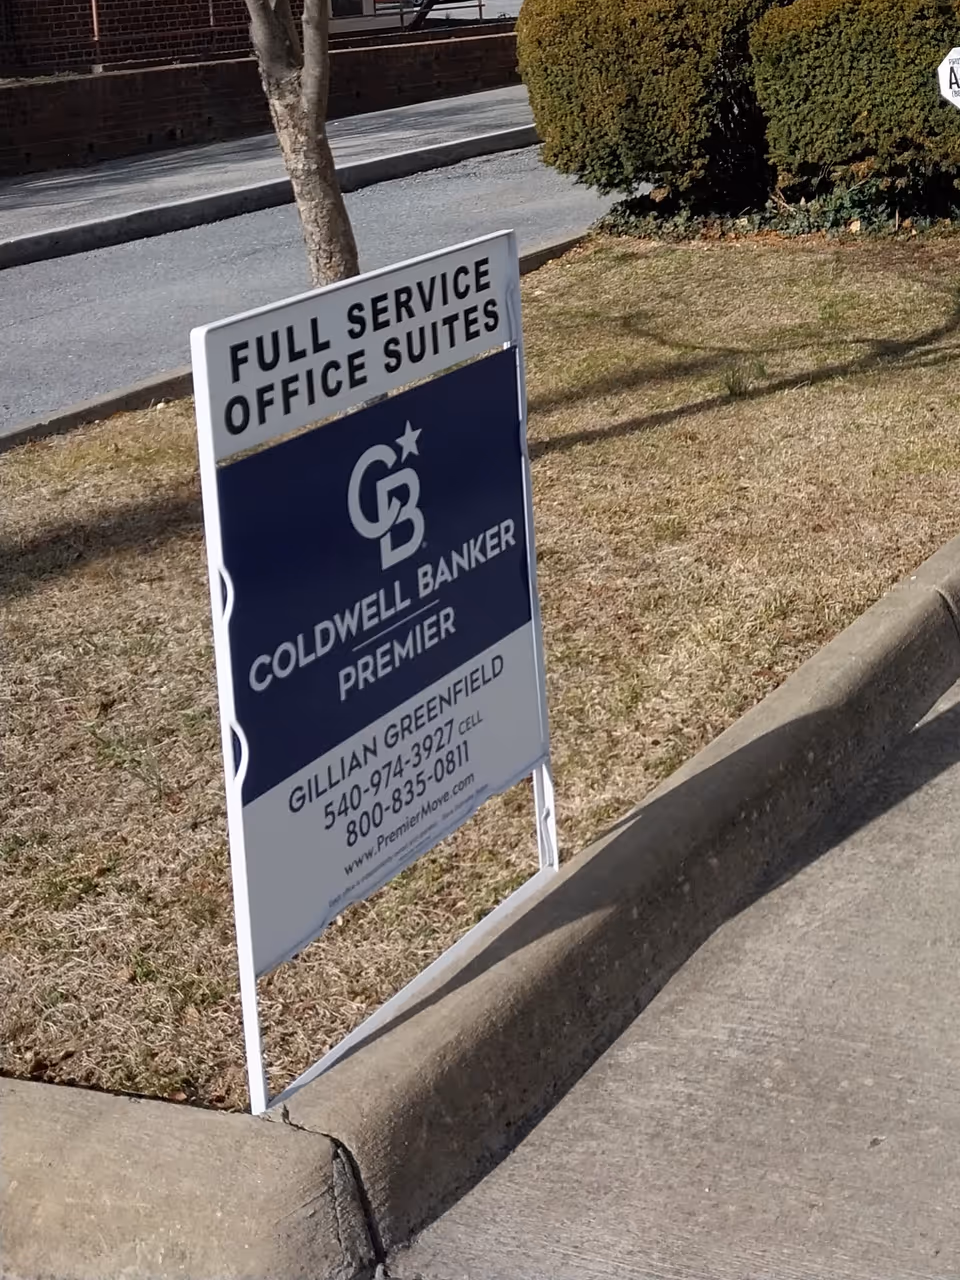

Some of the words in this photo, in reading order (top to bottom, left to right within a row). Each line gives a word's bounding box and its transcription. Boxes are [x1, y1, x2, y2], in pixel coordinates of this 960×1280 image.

[224, 349, 368, 436] OFFICE
[384, 298, 500, 373] SUITES
[229, 317, 331, 384] FULL
[347, 256, 491, 340] SERVICE
[248, 579, 412, 693] COLDWELL
[418, 518, 517, 598] BANKER
[338, 607, 457, 702] PREMIER
[288, 736, 378, 814] GILLIAN
[384, 654, 505, 750] GREENFIELD
[323, 718, 455, 831] 540-974-3927
[458, 710, 484, 736] CELL
[346, 740, 471, 848] 800-835-0811
[343, 772, 476, 876] www.PremierMove.com
